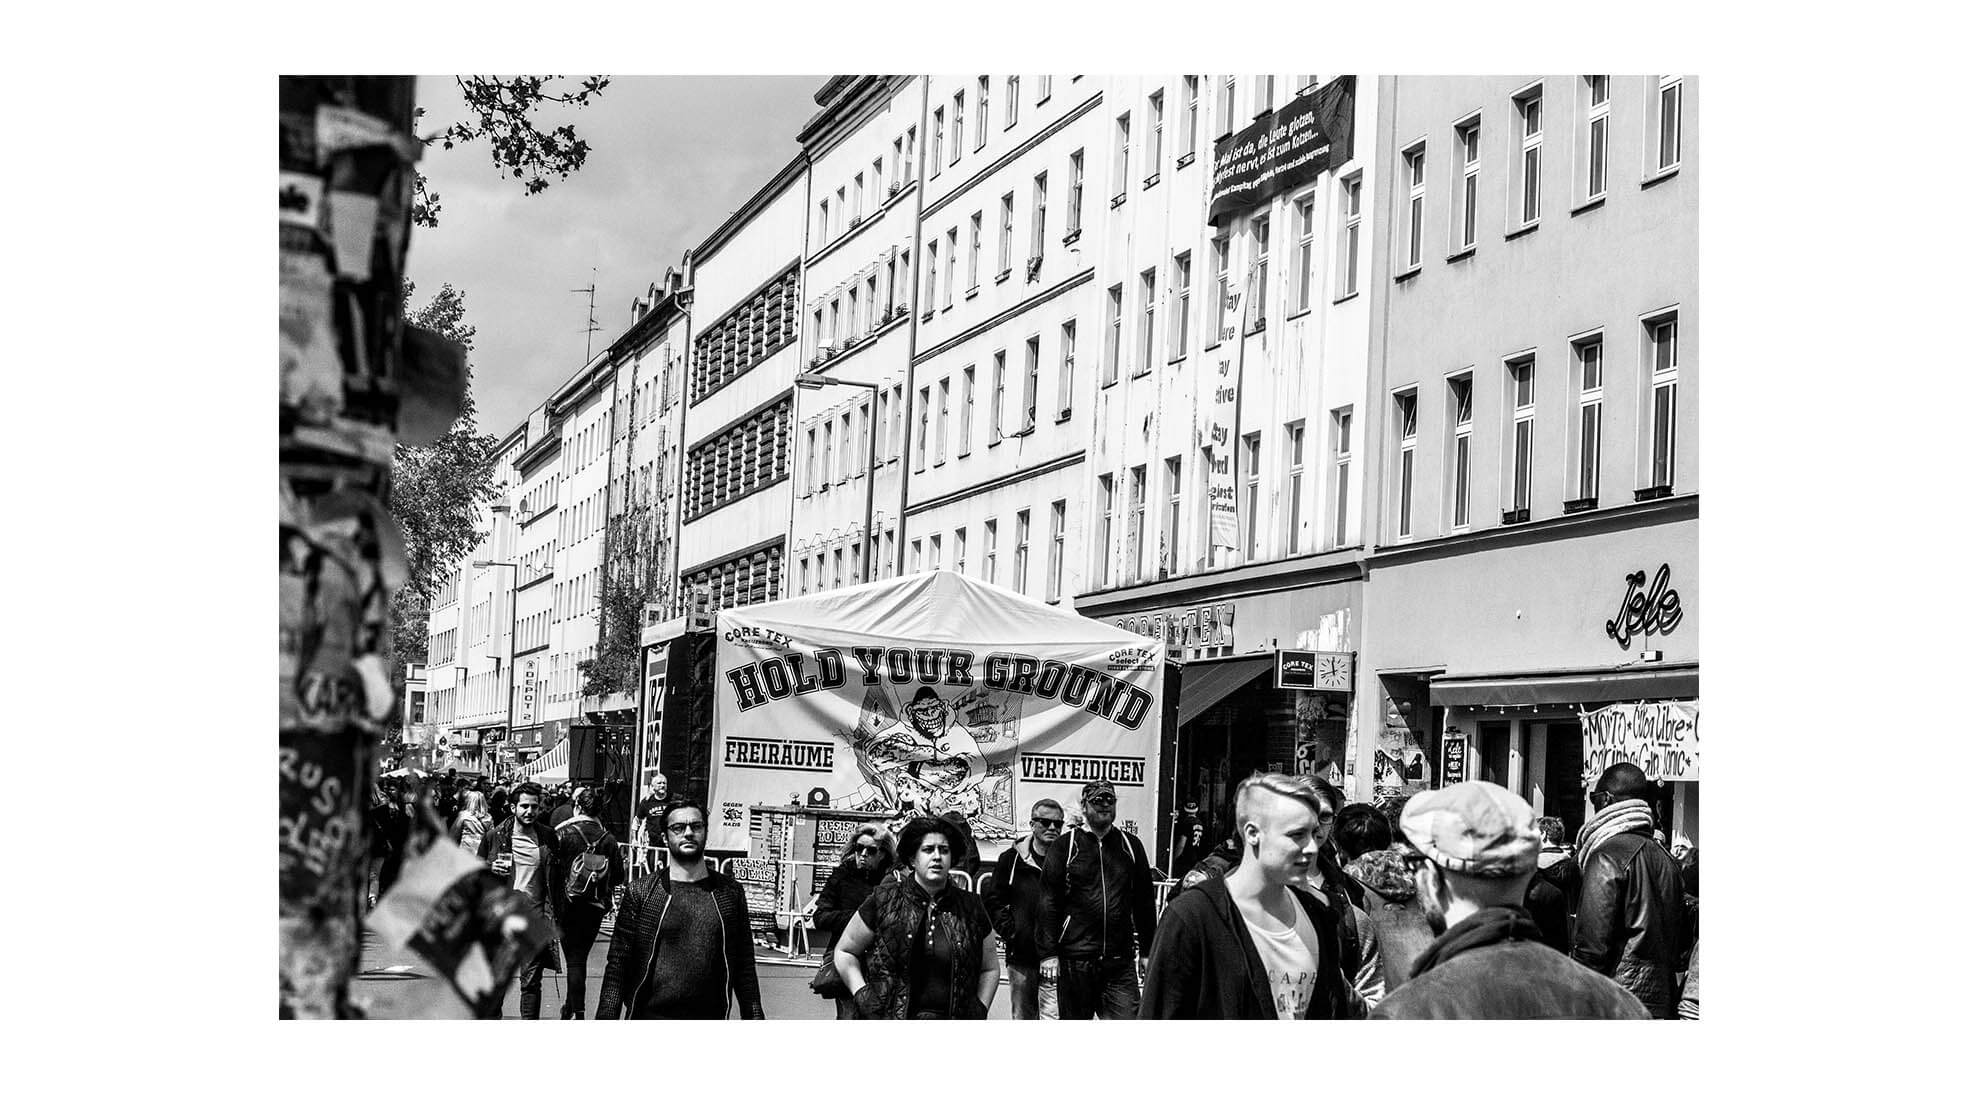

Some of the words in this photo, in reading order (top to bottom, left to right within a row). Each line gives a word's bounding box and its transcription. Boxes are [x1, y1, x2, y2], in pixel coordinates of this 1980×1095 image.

[1232, 147, 1243, 161] ist
[1243, 141, 1256, 156] da,
[1260, 154, 1267, 165] es
[1276, 141, 1291, 157] zum
[725, 627, 760, 642] CORE
[765, 629, 793, 649] TEX
[1109, 648, 1134, 661] CORE
[1136, 648, 1156, 661] TEX
[1282, 661, 1300, 670] CORE
[1300, 661, 1313, 671] TEX
[524, 671, 535, 710] DEPOT
[725, 648, 847, 713] HOLD
[851, 646, 975, 687] YOUR
[982, 651, 1155, 732] GROUND
[725, 739, 834, 767] FREIRÄUME
[1020, 757, 1145, 782] VERTEIDIGEN
